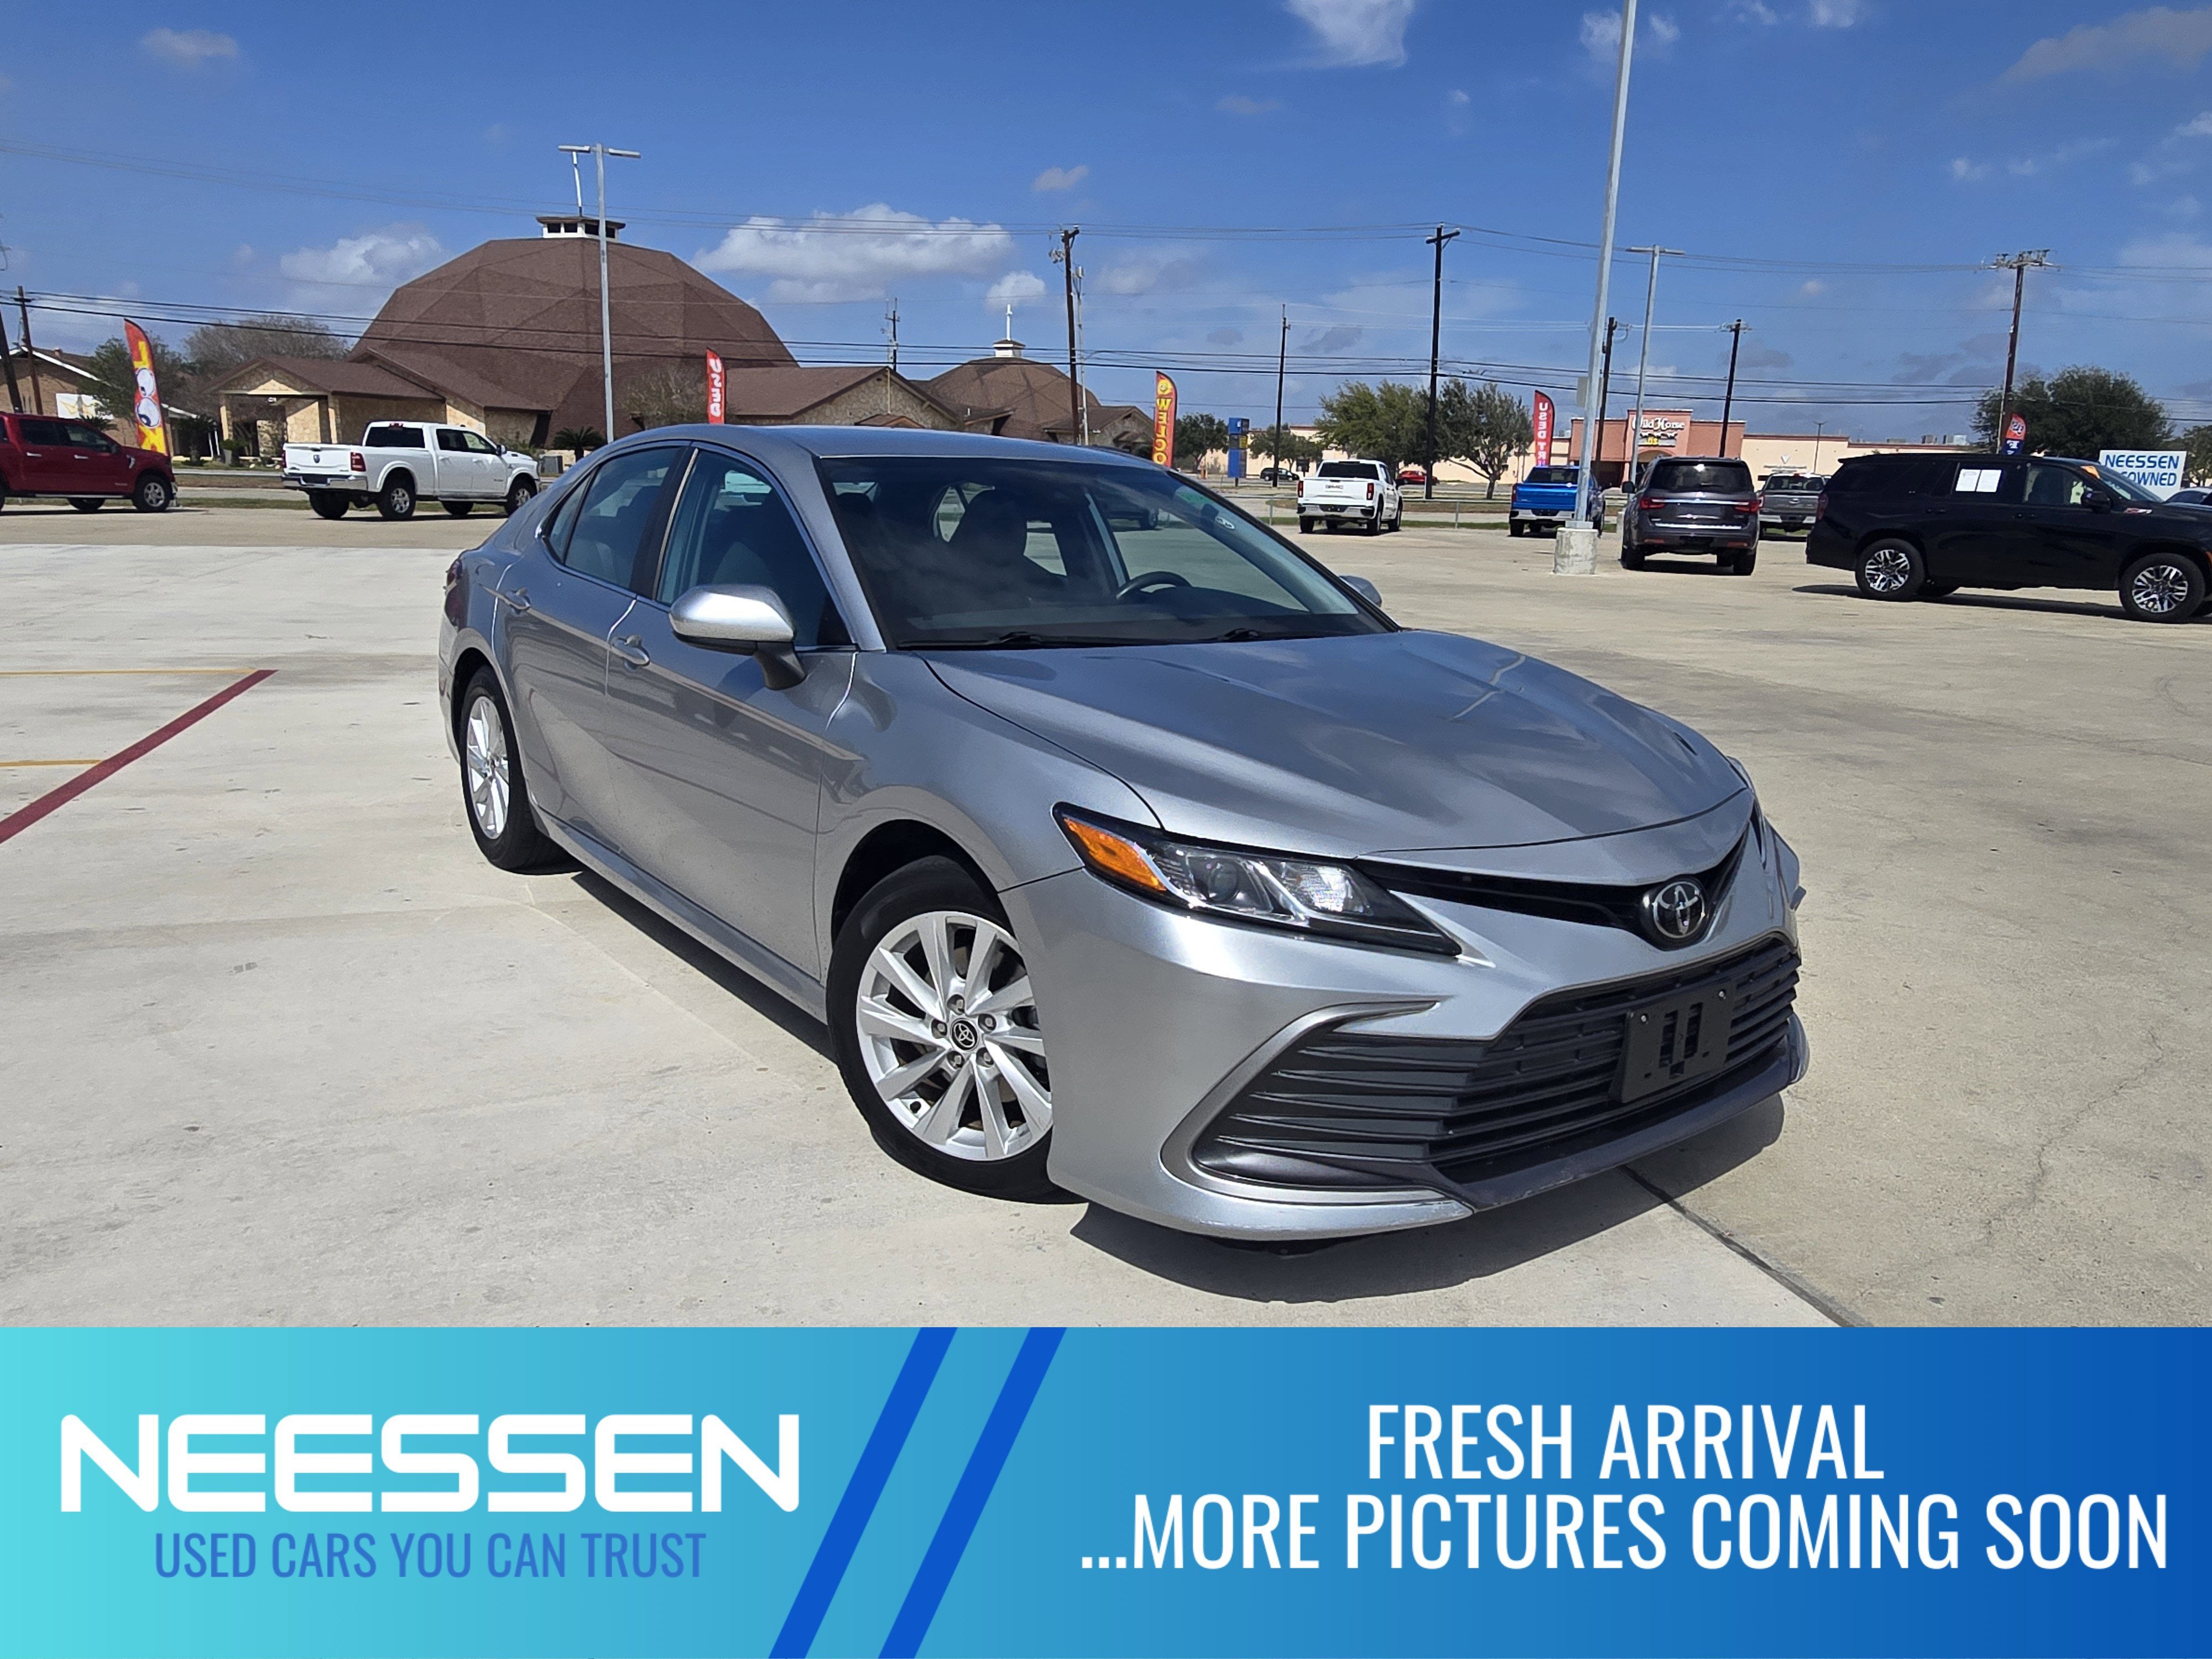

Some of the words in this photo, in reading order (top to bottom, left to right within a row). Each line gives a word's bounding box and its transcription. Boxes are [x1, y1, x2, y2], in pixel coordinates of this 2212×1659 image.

[1653, 417, 1686, 431] Horse
[2105, 454, 2179, 469] NEESSEN
[2120, 471, 2177, 486] OWNED
